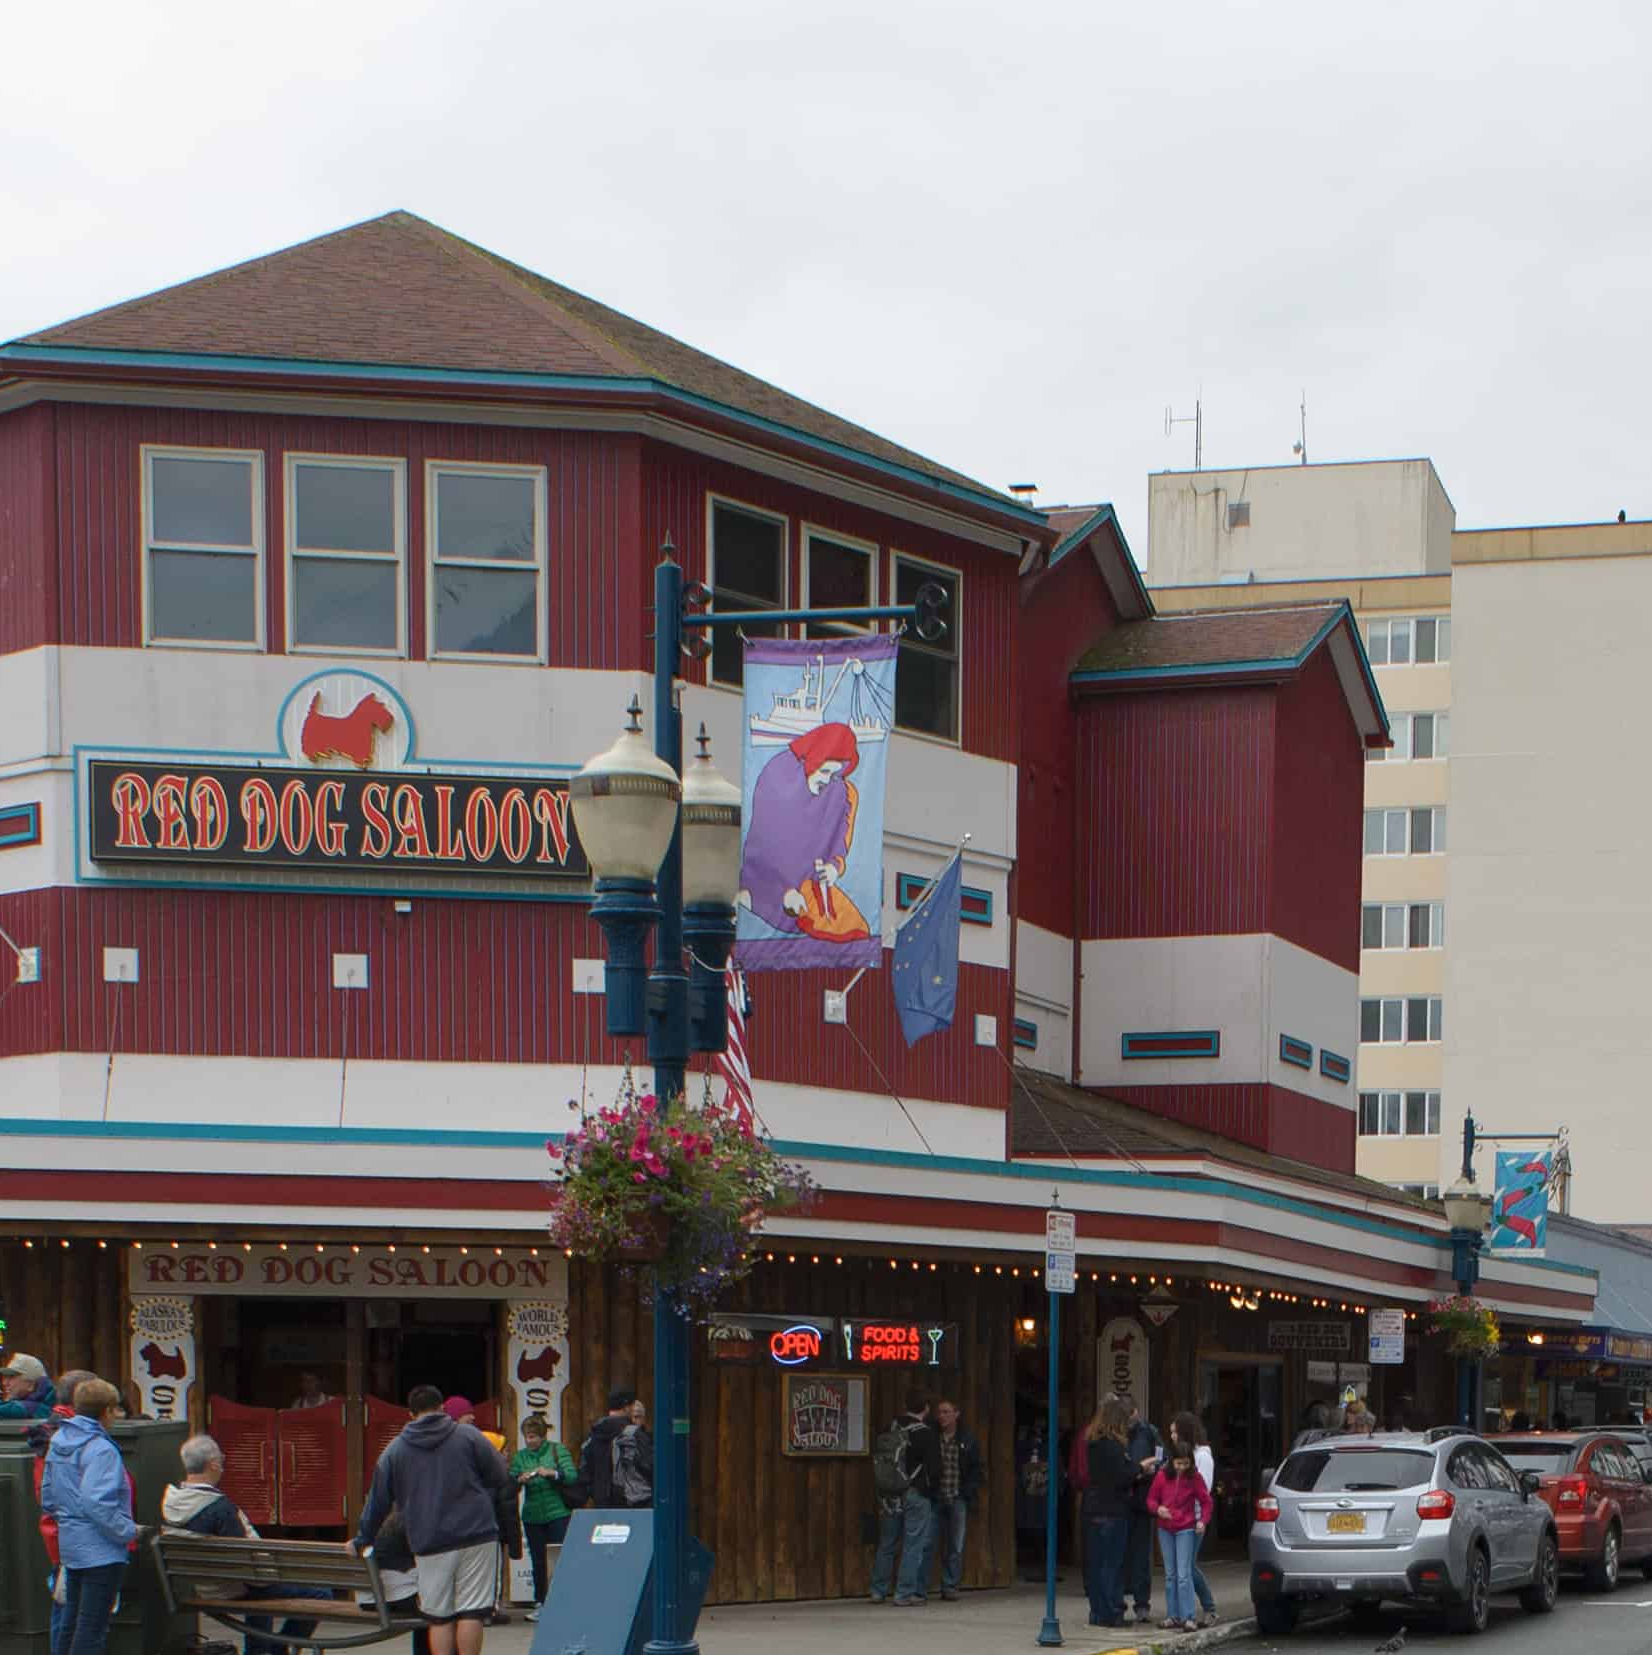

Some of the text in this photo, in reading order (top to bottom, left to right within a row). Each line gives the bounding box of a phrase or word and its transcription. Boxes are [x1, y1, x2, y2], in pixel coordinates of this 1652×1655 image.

[111, 772, 572, 866] RED DOG SALOON
[143, 1253, 553, 1288] RED DOG SALOON
[518, 1309, 559, 1322] WORLD
[516, 1322, 561, 1337] FAMOUS
[863, 1326, 920, 1343] FOOD &
[770, 1331, 820, 1357] OPEN
[860, 1344, 920, 1361] SPIRITS
